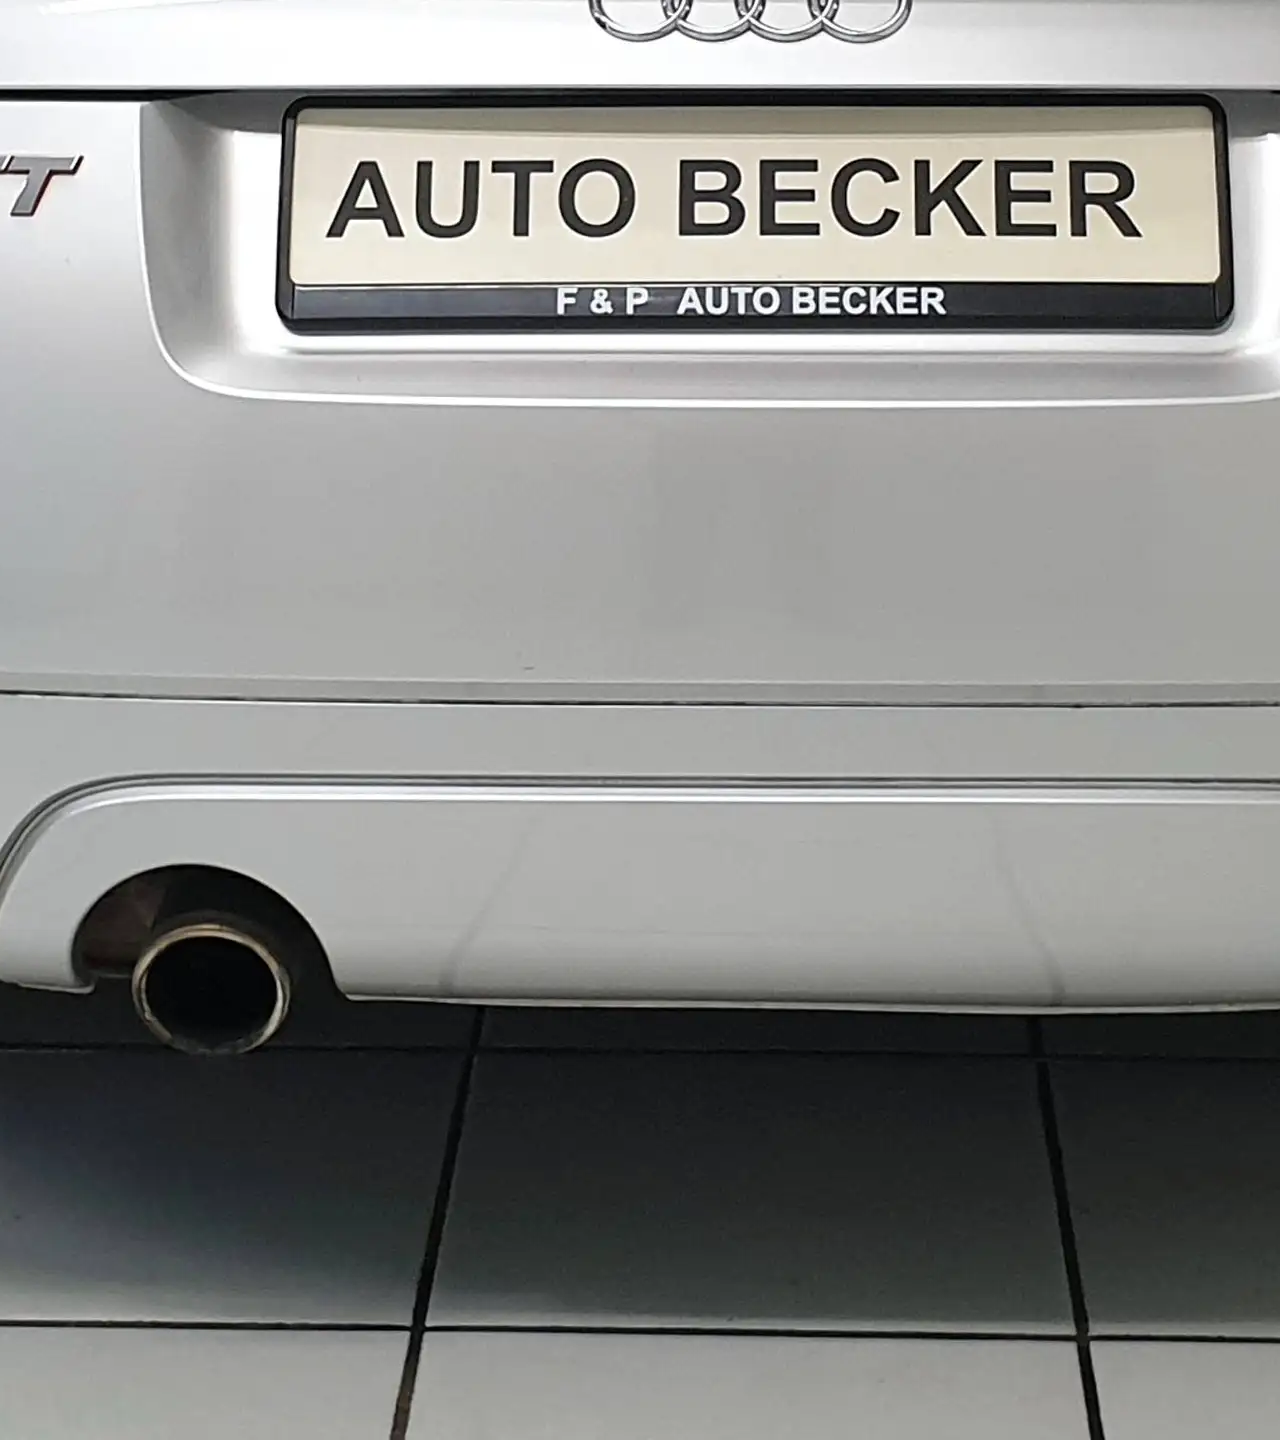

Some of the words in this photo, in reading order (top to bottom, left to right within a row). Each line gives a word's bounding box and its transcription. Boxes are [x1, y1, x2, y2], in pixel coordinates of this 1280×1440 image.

[326, 160, 636, 238] AUTO
[678, 158, 1142, 238] BECKER
[556, 286, 579, 316] F
[589, 287, 614, 316] &
[626, 286, 650, 316] P
[676, 286, 782, 317] AUTO
[792, 285, 948, 317] BECKER
